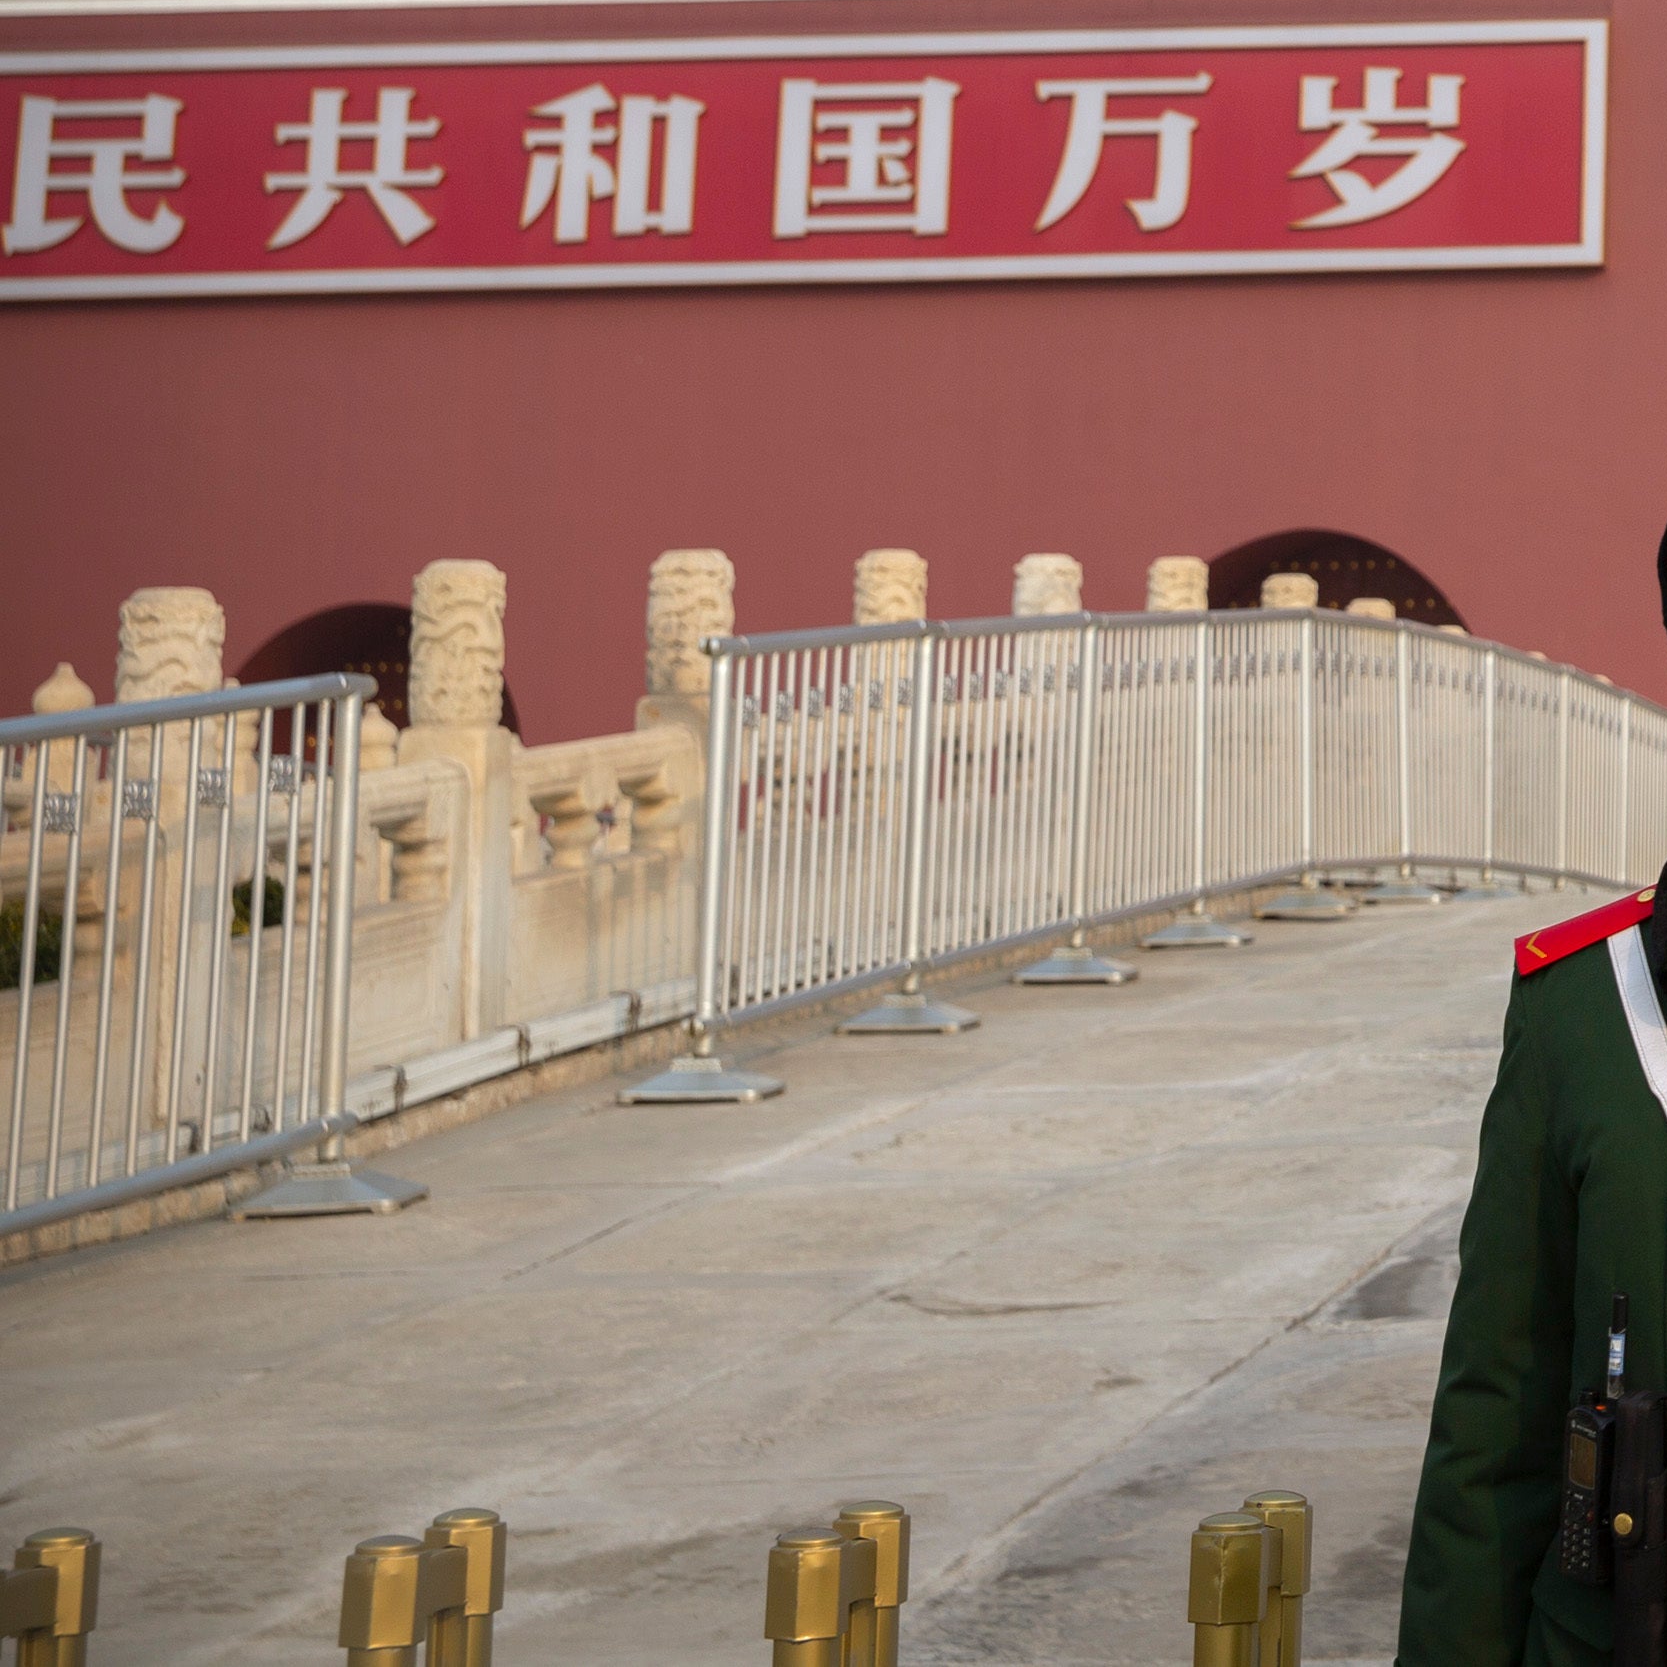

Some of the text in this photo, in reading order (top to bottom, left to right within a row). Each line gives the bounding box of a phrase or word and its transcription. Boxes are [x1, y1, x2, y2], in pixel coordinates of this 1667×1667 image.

[1, 65, 1468, 255] 民共和国万岁
